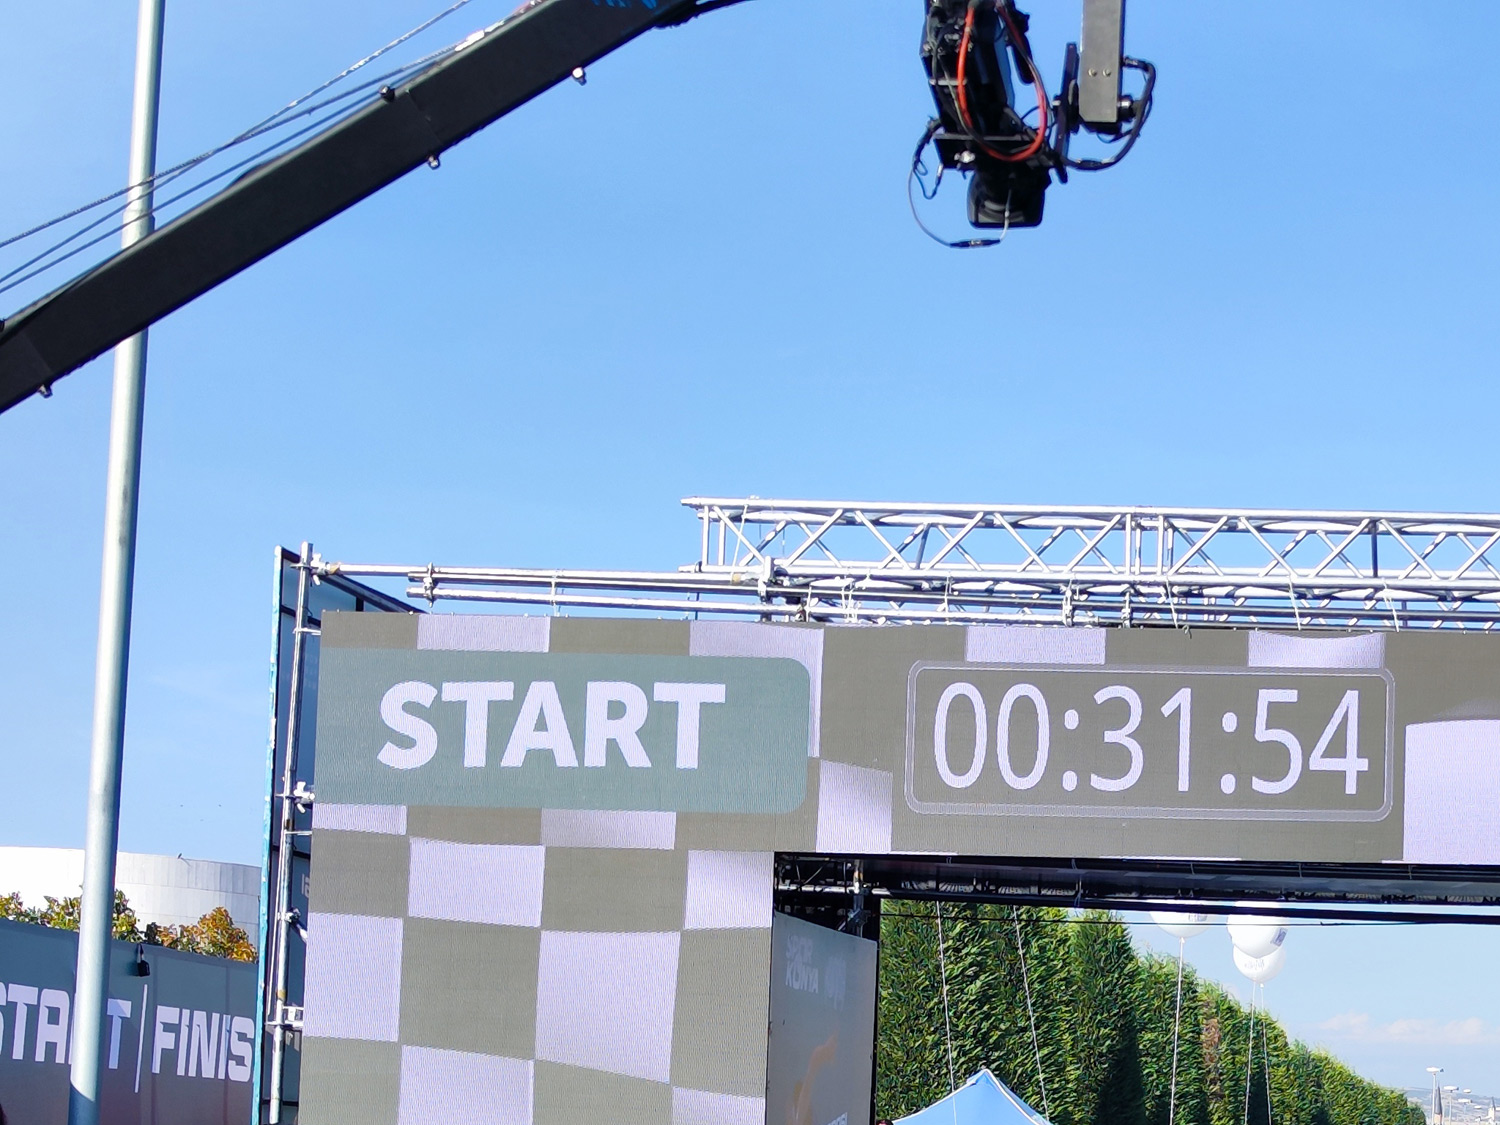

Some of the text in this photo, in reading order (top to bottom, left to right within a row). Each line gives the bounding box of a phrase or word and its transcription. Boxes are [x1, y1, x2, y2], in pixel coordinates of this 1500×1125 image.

[375, 679, 727, 772] START
[934, 681, 1369, 796] 00:31:54
[0, 981, 132, 1070] TAT
